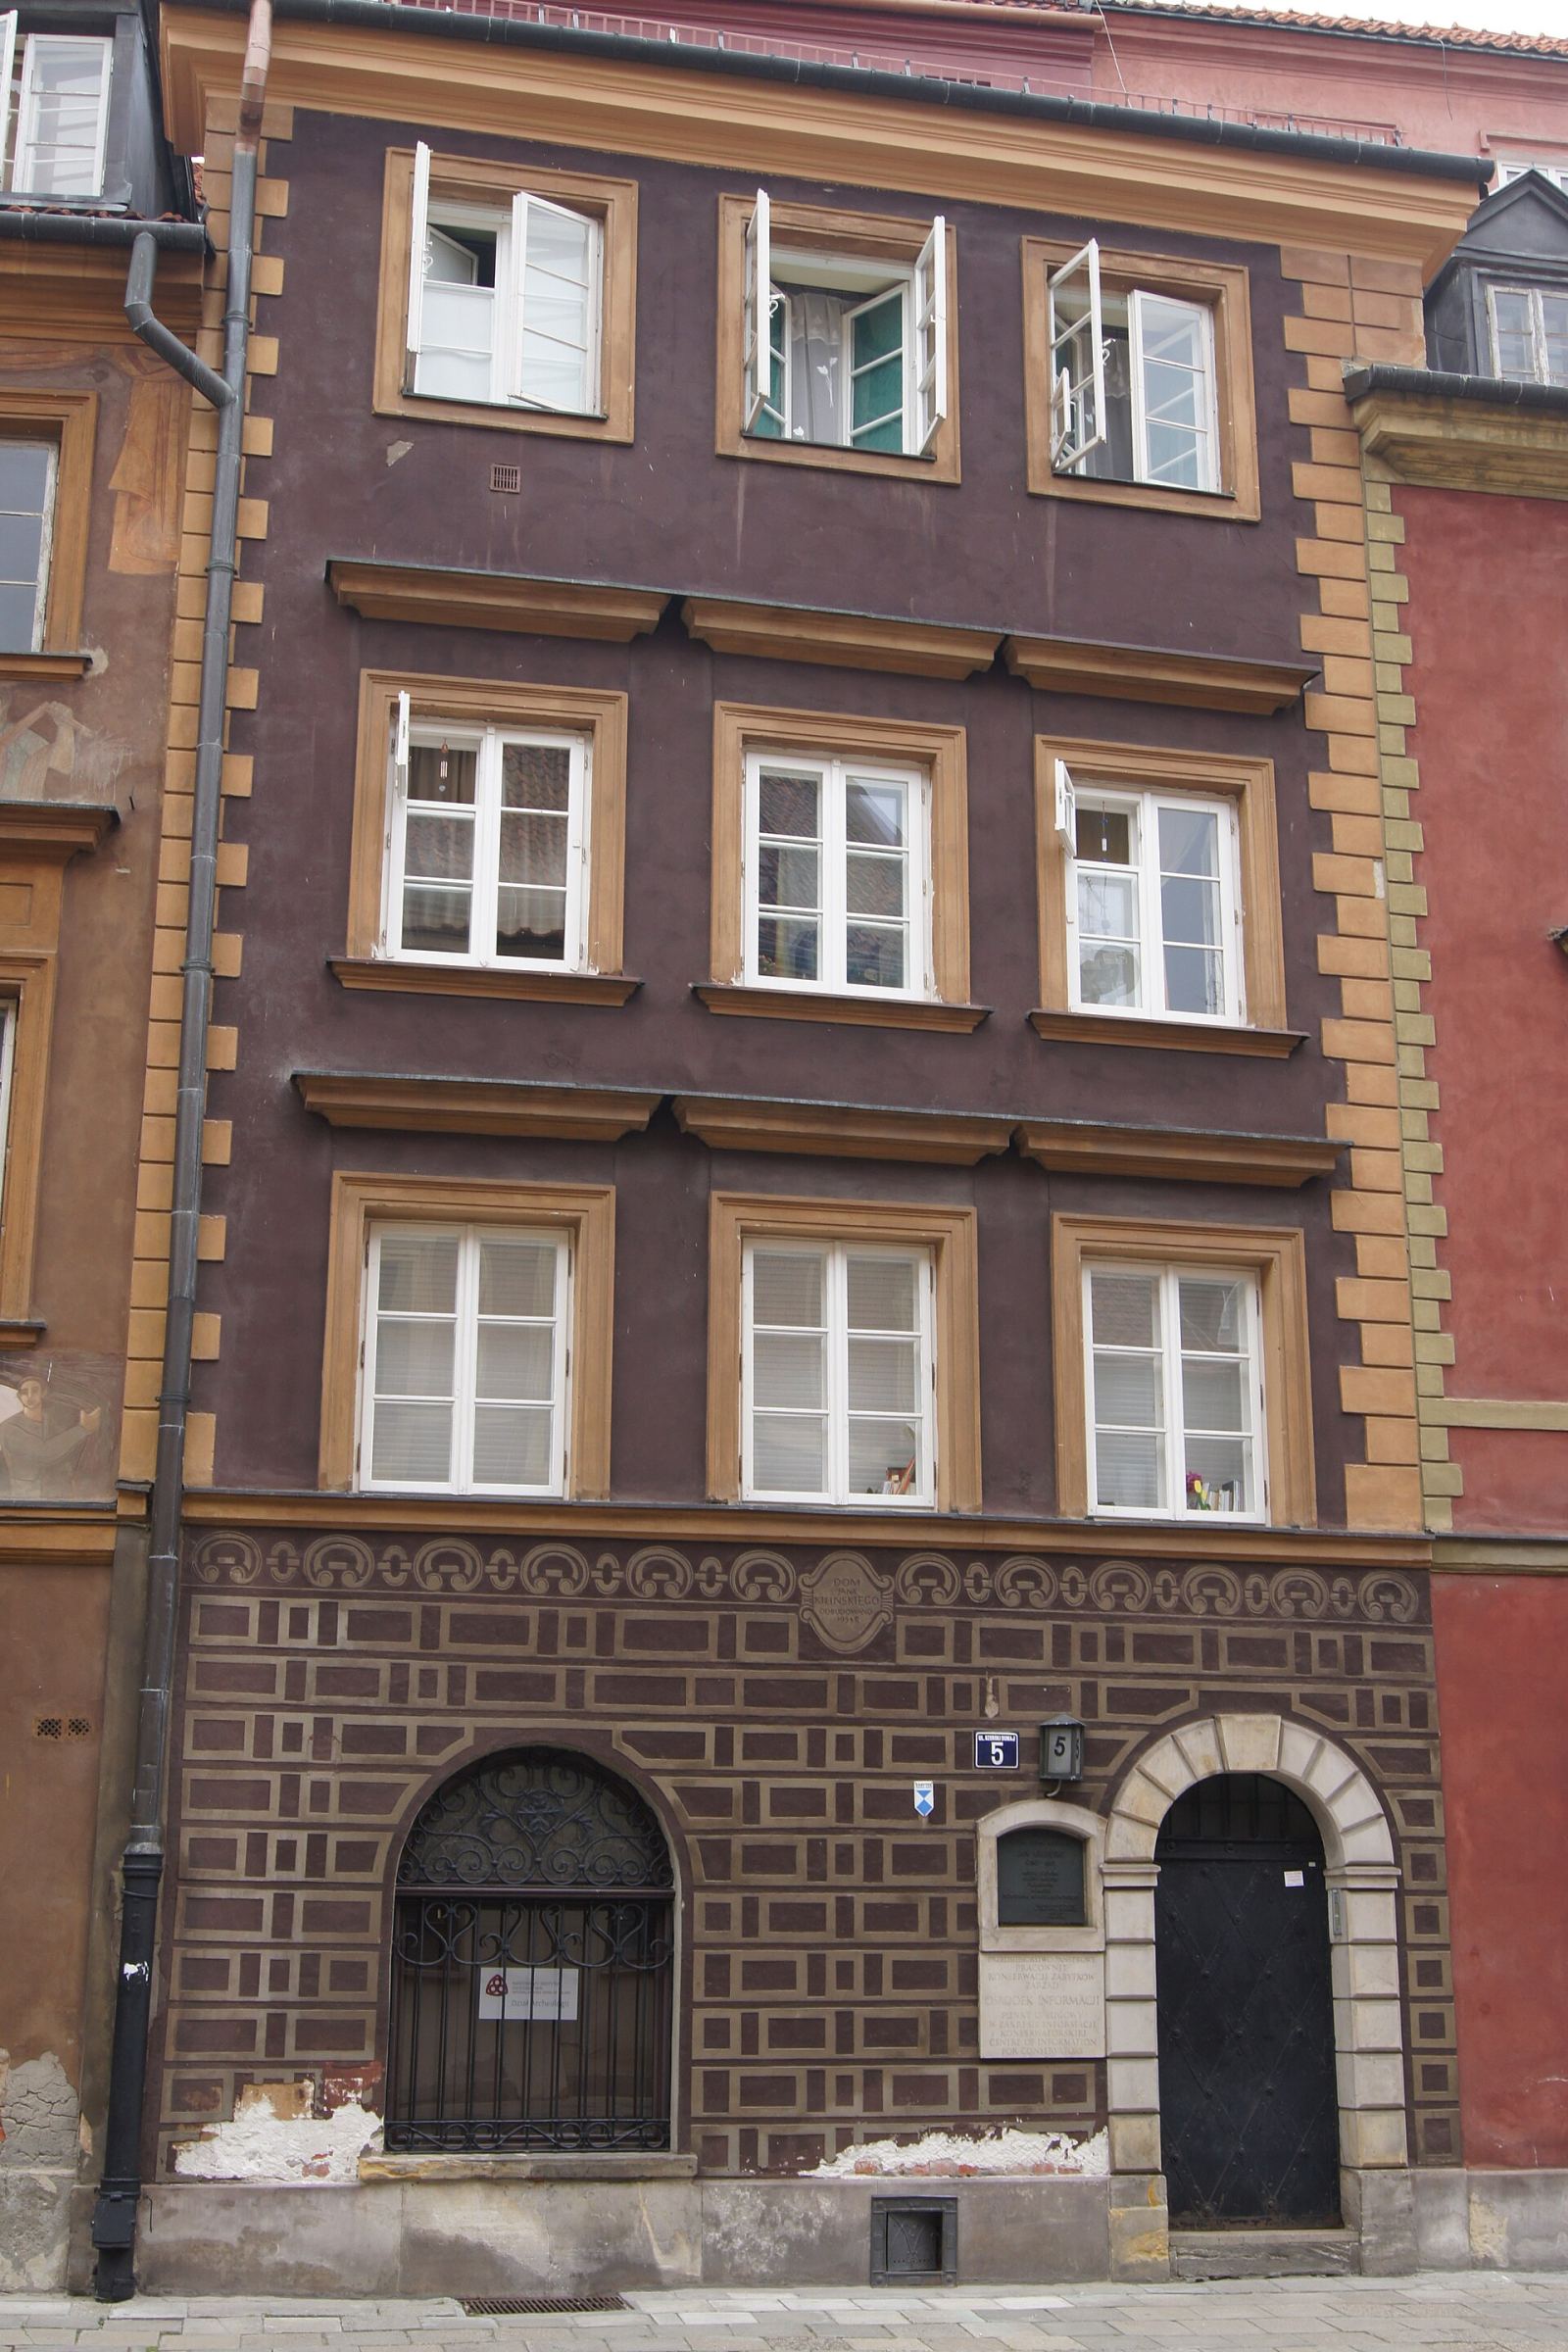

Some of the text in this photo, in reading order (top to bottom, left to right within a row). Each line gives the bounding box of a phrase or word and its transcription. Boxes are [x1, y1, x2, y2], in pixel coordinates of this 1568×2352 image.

[834, 1578, 860, 1587] DOM
[991, 1741, 1004, 1766] 5
[1054, 1736, 1066, 1757] 5
